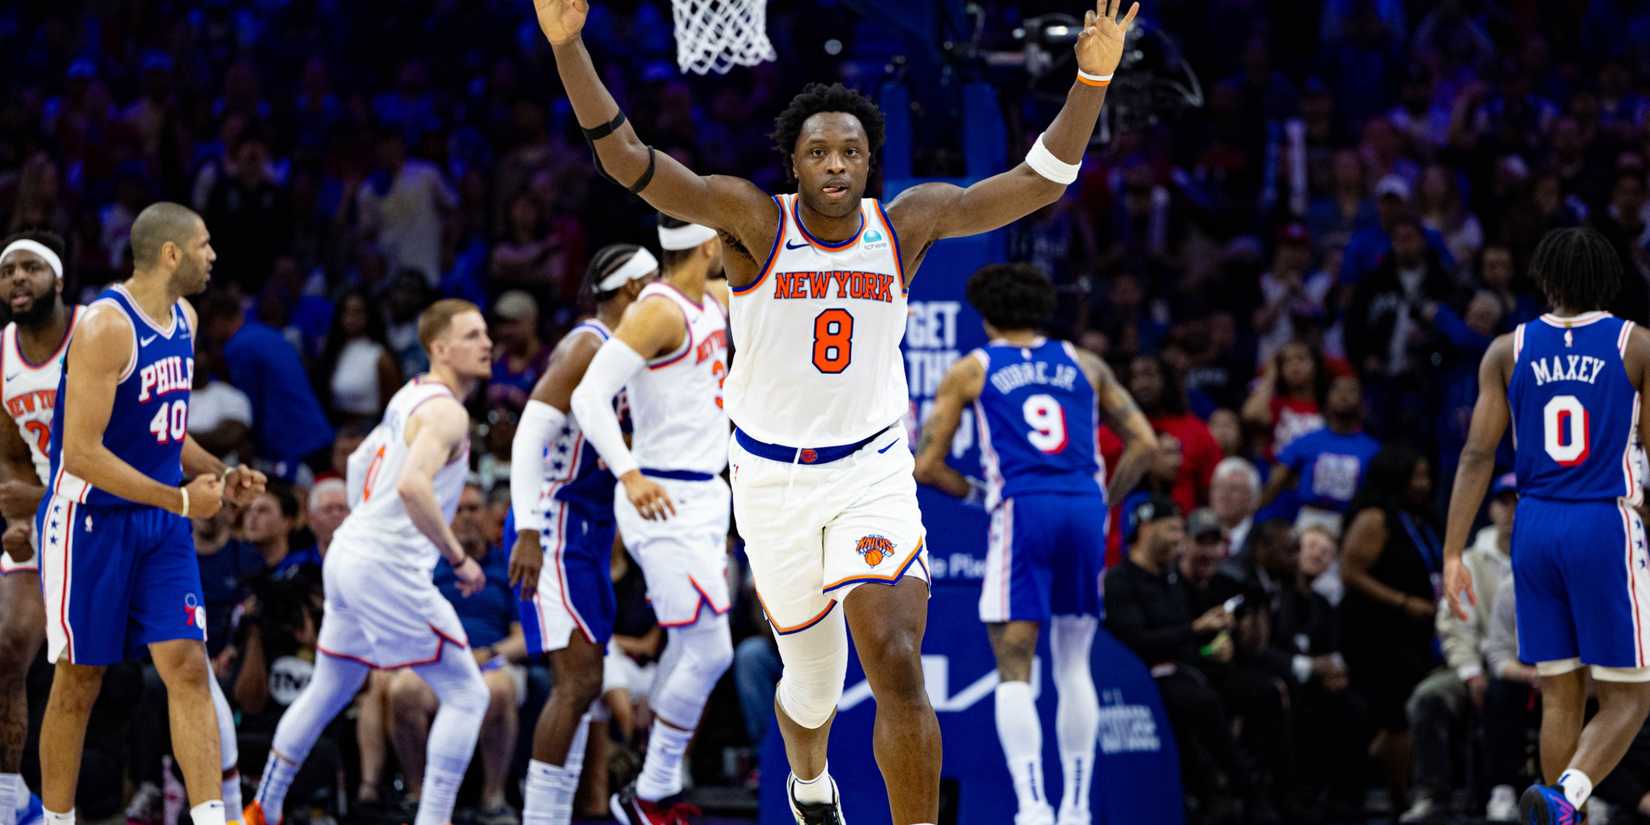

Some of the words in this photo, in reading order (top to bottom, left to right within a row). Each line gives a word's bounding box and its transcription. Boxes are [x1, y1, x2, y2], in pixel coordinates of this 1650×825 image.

[774, 272, 831, 299] NEW
[833, 271, 894, 303] YORK
[811, 308, 854, 374] 8
[906, 301, 961, 349] GET
[906, 350, 961, 398] TH
[1531, 355, 1605, 386] MAXEY
[150, 400, 187, 444] 40
[1023, 393, 1070, 455] 9
[1544, 396, 1590, 467] 0
